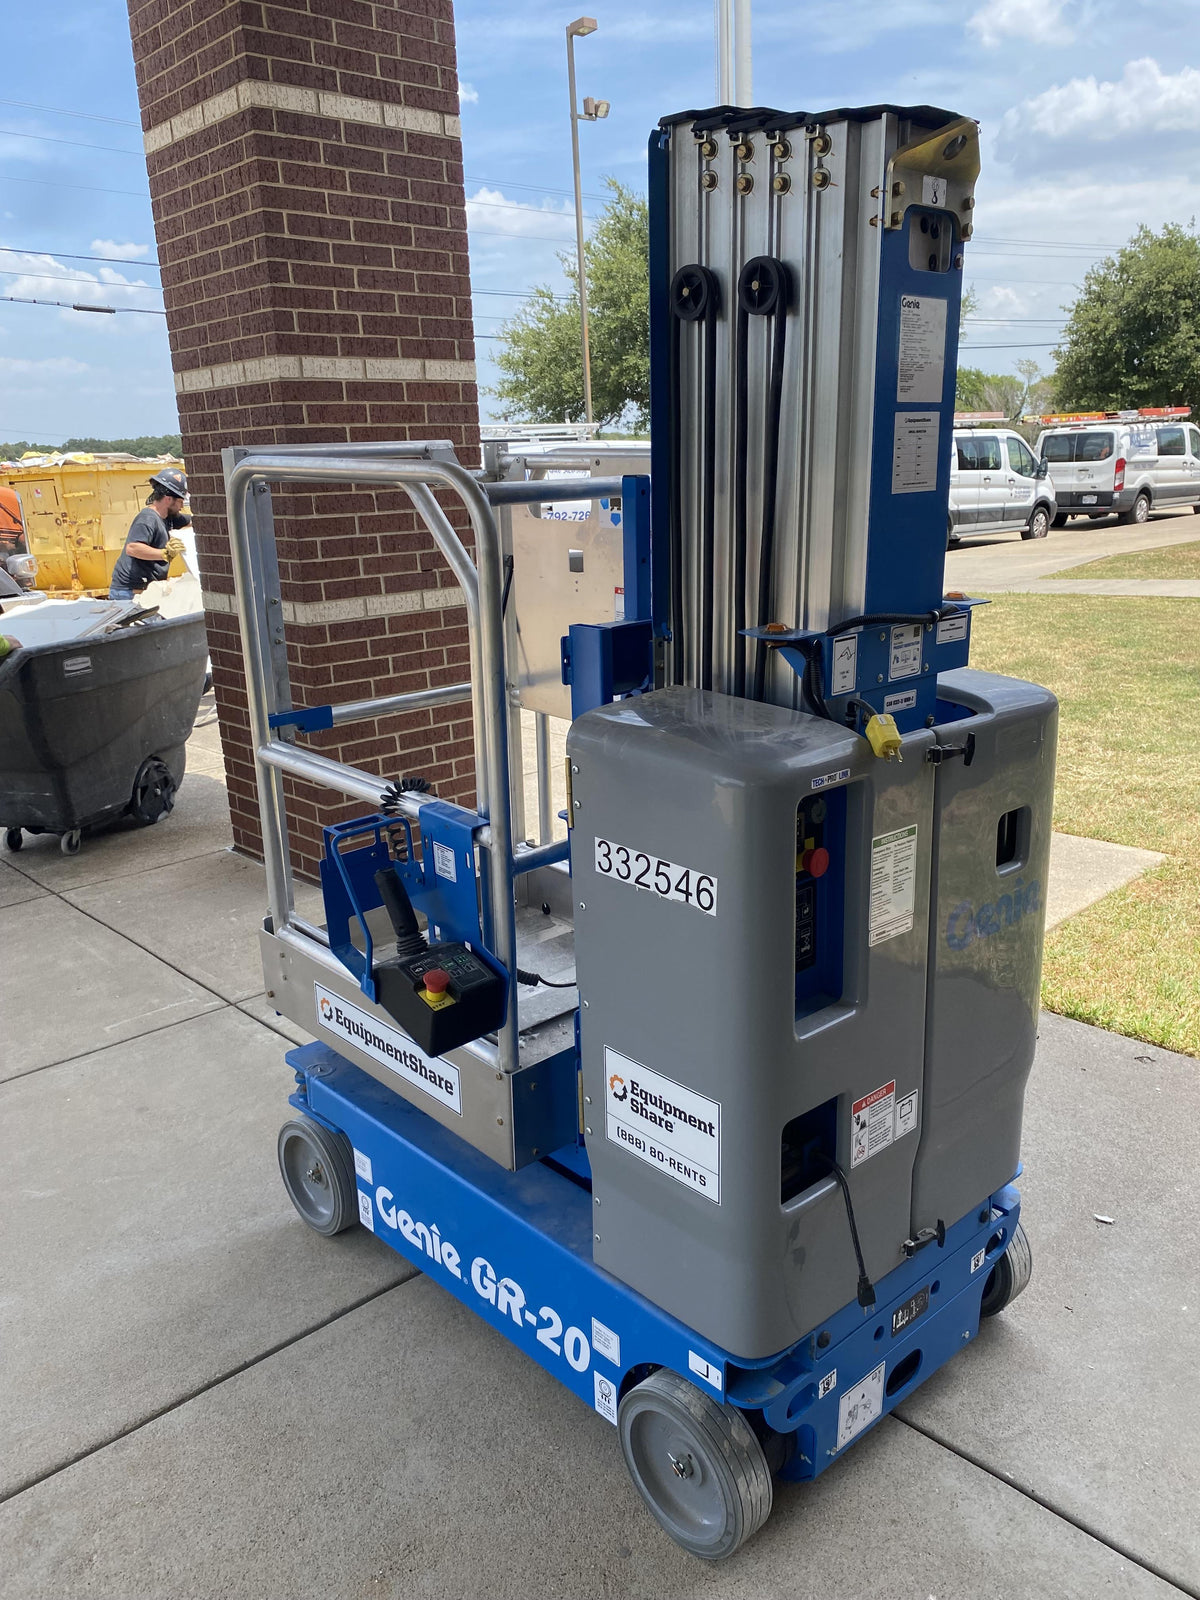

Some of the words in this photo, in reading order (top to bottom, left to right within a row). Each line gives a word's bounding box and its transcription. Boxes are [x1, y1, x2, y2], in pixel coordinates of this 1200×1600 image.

[901, 297, 920, 309] Genie
[597, 840, 714, 911] 332546
[334, 1006, 454, 1096] EquipmentShare
[629, 1079, 716, 1138] Equipment
[630, 1097, 674, 1133] Share
[866, 1088, 887, 1106] DANGER
[616, 1126, 646, 1153] (888)
[649, 1146, 707, 1187] 80-RENTS
[375, 1185, 462, 1280] Genie
[471, 1256, 591, 1373] GR-20
